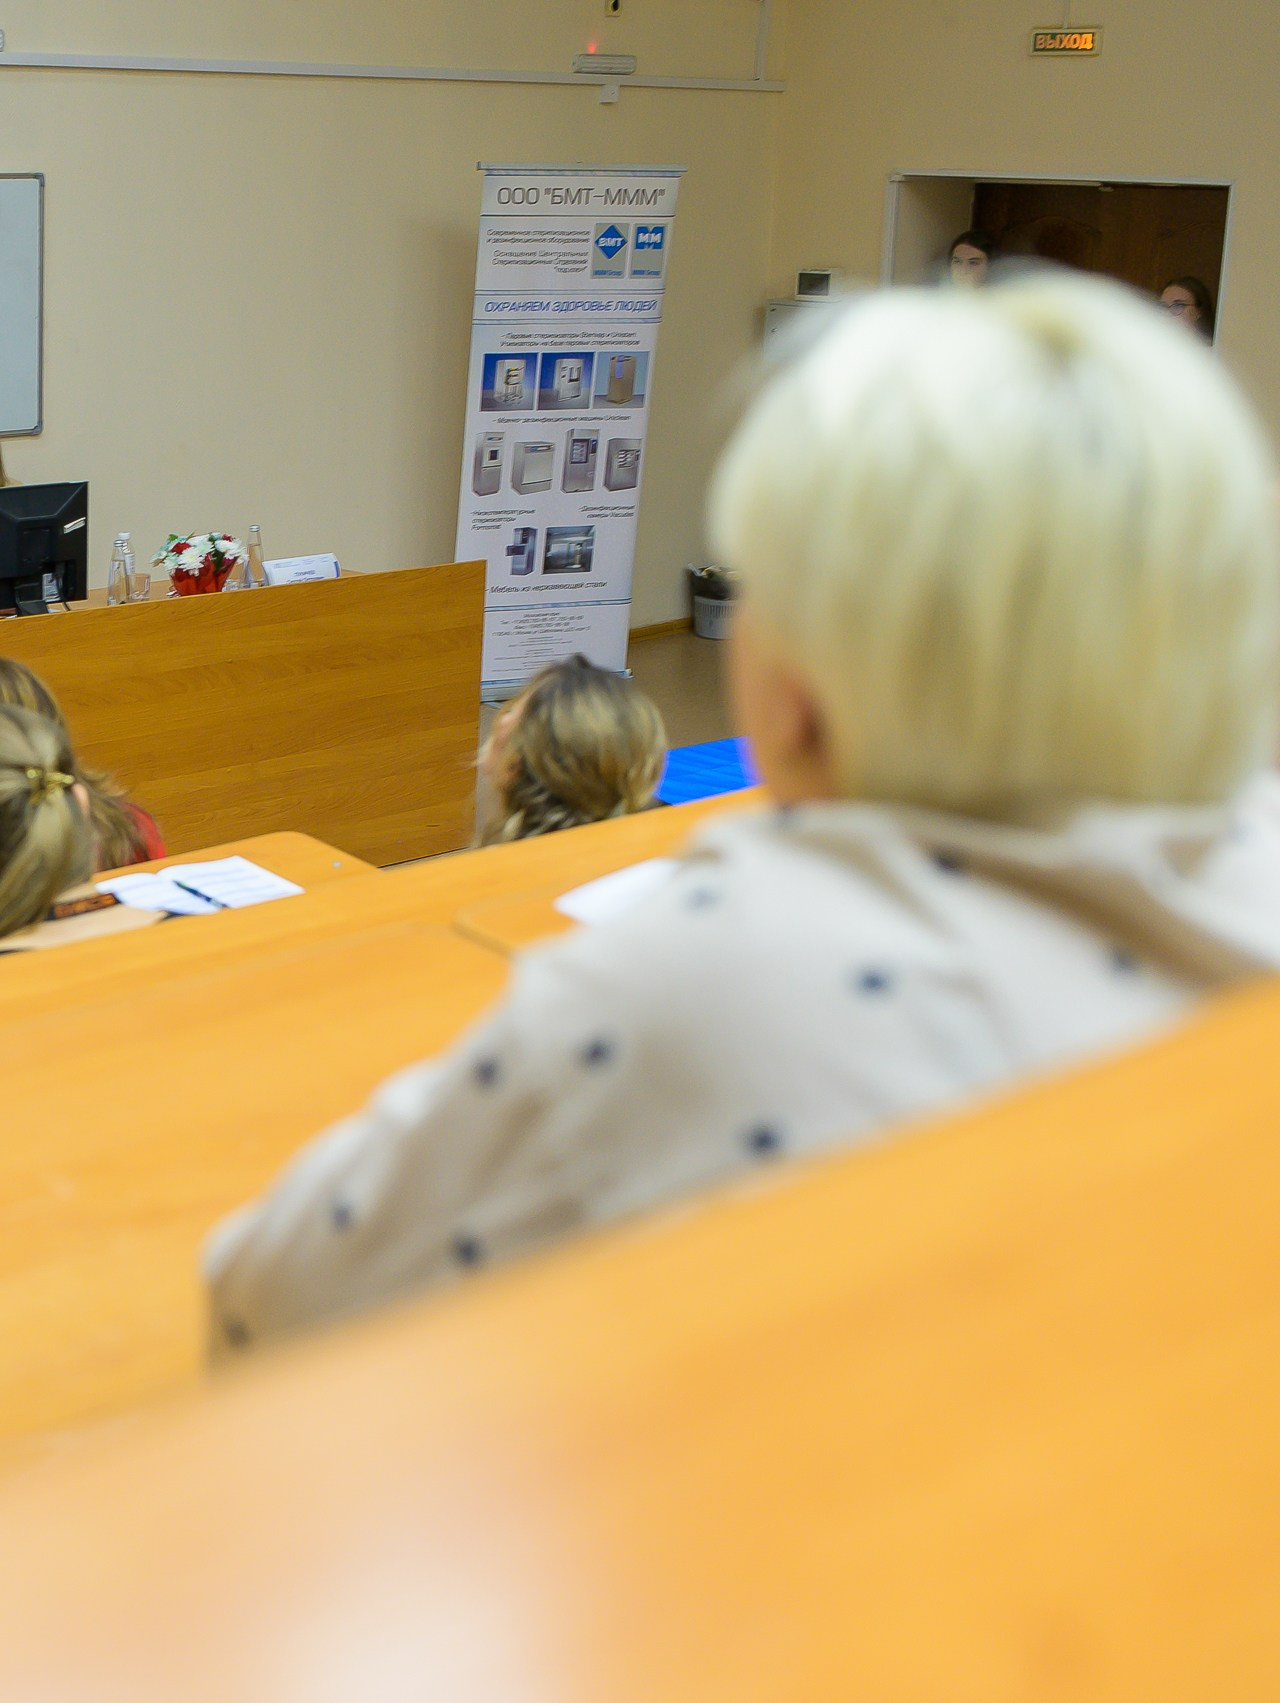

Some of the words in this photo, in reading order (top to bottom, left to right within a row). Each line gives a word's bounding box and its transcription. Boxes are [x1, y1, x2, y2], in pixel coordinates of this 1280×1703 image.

[1035, 33, 1093, 49] ВЫХОД
[497, 187, 540, 205] ООО
[544, 187, 666, 206] "БМТ-МММ"
[484, 301, 550, 312] ОХРАНЯЕМ
[551, 301, 613, 313] ЗДОРОВЬЕ
[613, 300, 658, 313] ЛЮДЕЙ
